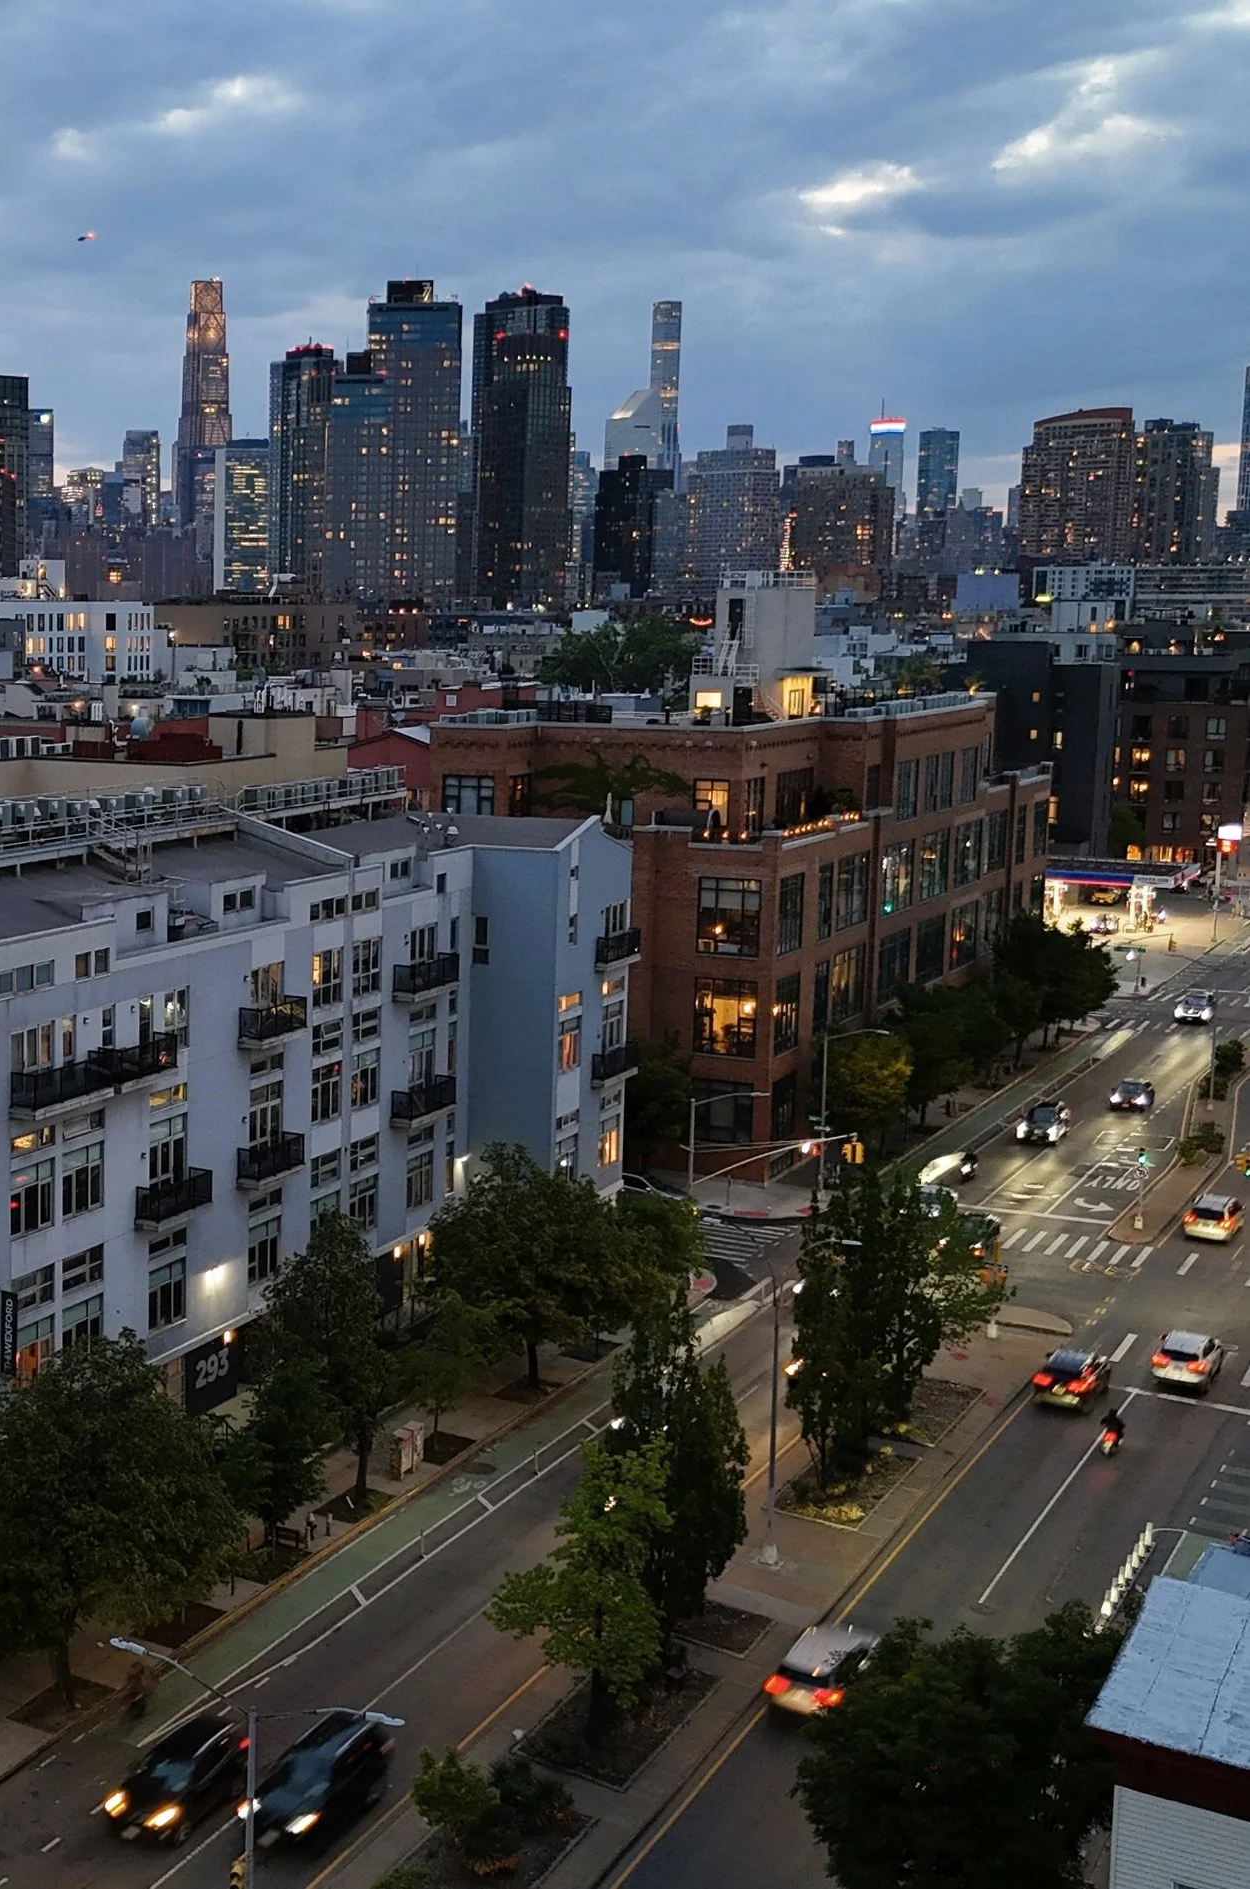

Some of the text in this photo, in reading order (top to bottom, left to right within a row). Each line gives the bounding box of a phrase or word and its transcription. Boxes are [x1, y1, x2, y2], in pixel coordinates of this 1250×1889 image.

[1084, 1175, 1141, 1191] ONLY
[4, 1298, 13, 1353] WEXFORD
[195, 1347, 229, 1389] 293
